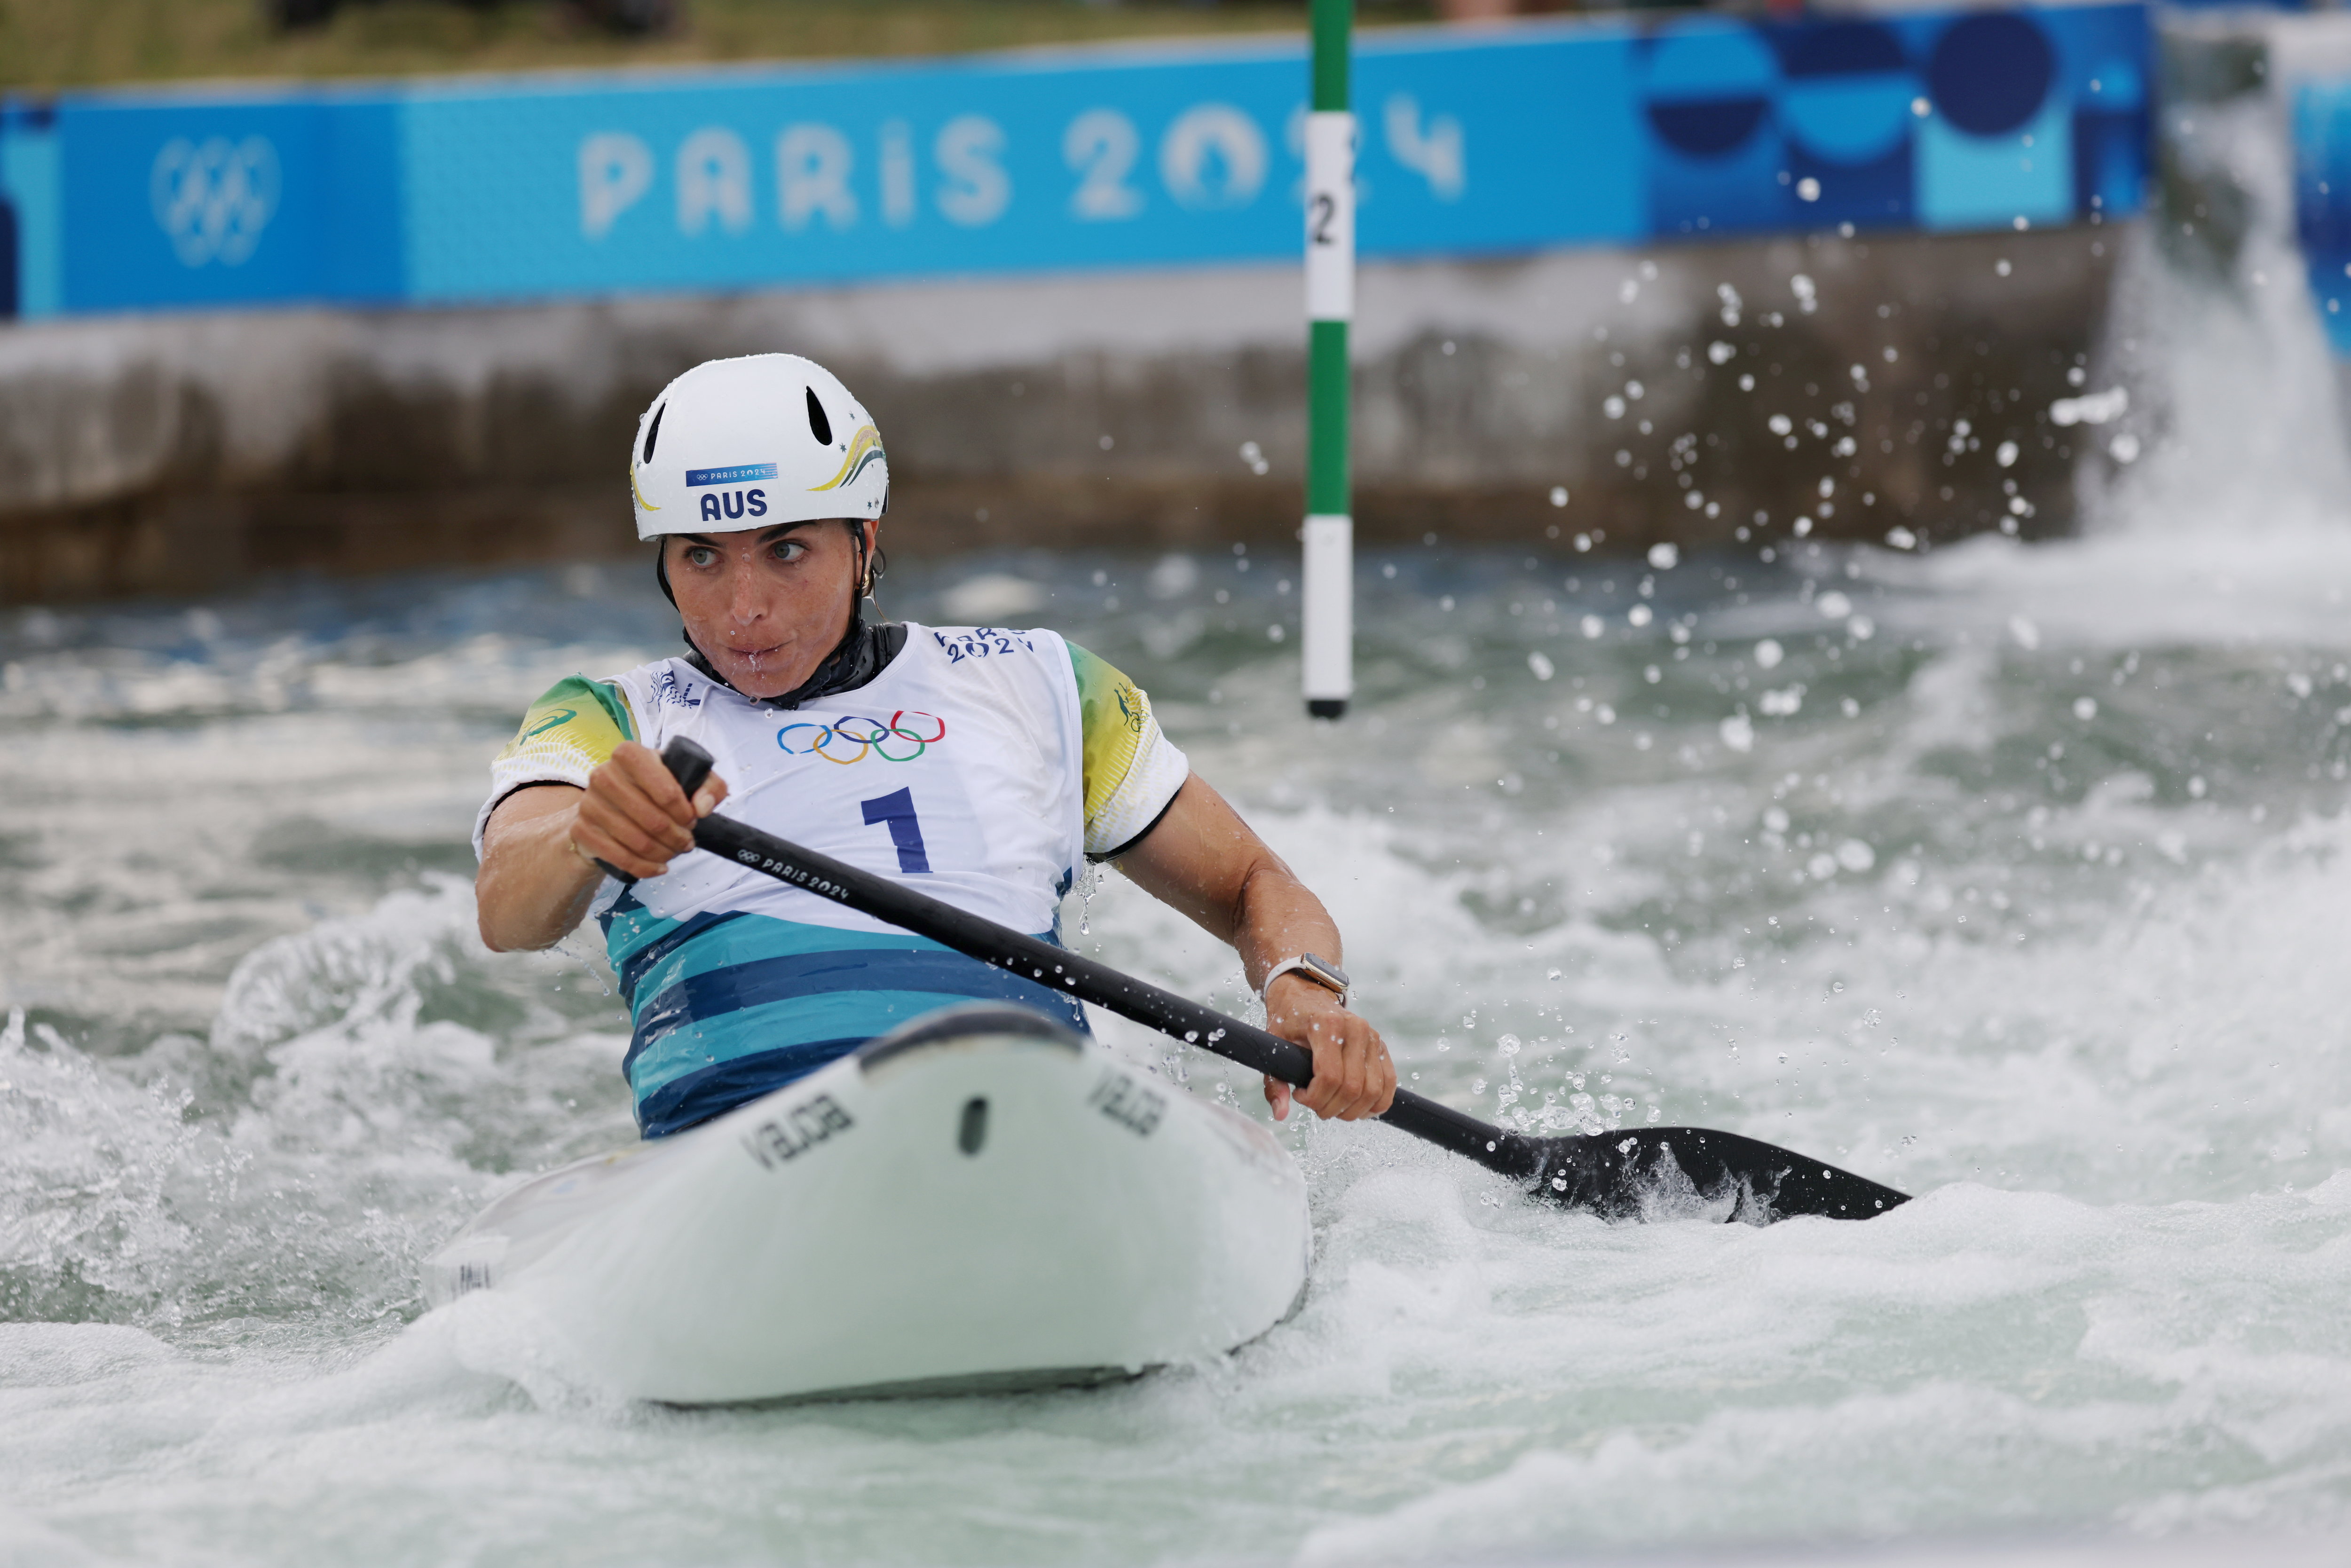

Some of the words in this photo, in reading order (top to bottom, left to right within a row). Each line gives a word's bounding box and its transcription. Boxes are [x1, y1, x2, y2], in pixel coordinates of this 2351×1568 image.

[1309, 193, 1337, 245] 2
[740, 468, 765, 477] 2024
[700, 489, 767, 521] AUS
[860, 786, 933, 874] 1
[807, 876, 849, 899] 2024
